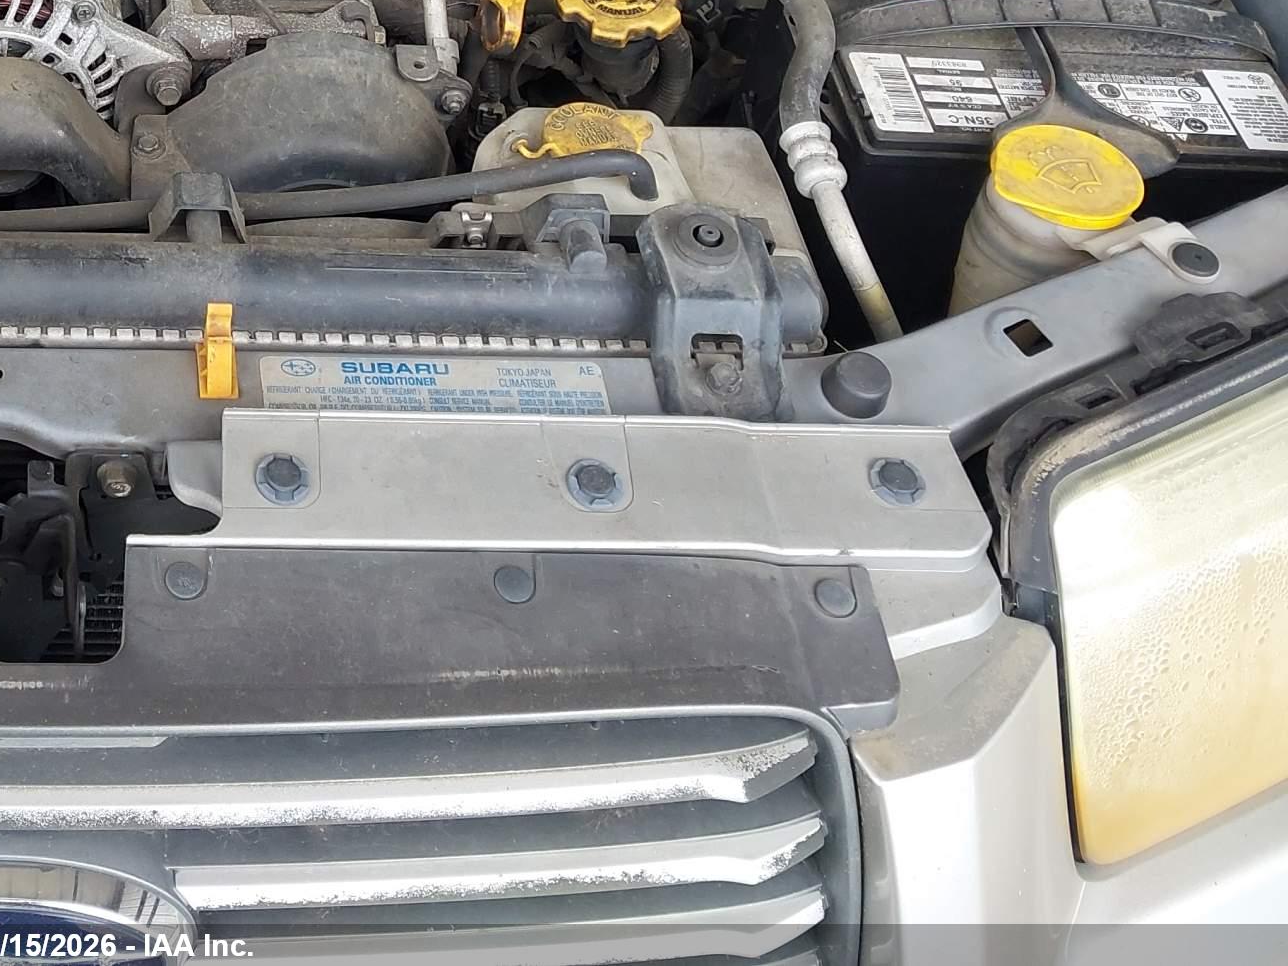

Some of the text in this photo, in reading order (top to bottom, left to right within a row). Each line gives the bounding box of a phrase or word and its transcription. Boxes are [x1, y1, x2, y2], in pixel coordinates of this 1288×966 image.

[596, 4, 647, 16] MANUAL
[951, 95, 973, 103] 640
[551, 105, 617, 131] COOLANT
[947, 114, 994, 126] 35N-C
[340, 361, 596, 377] SUBARU TOKYO JAPAN AE
[344, 376, 437, 386] AIR CONDITIONER
[498, 378, 557, 388] CLIMATISEUR
